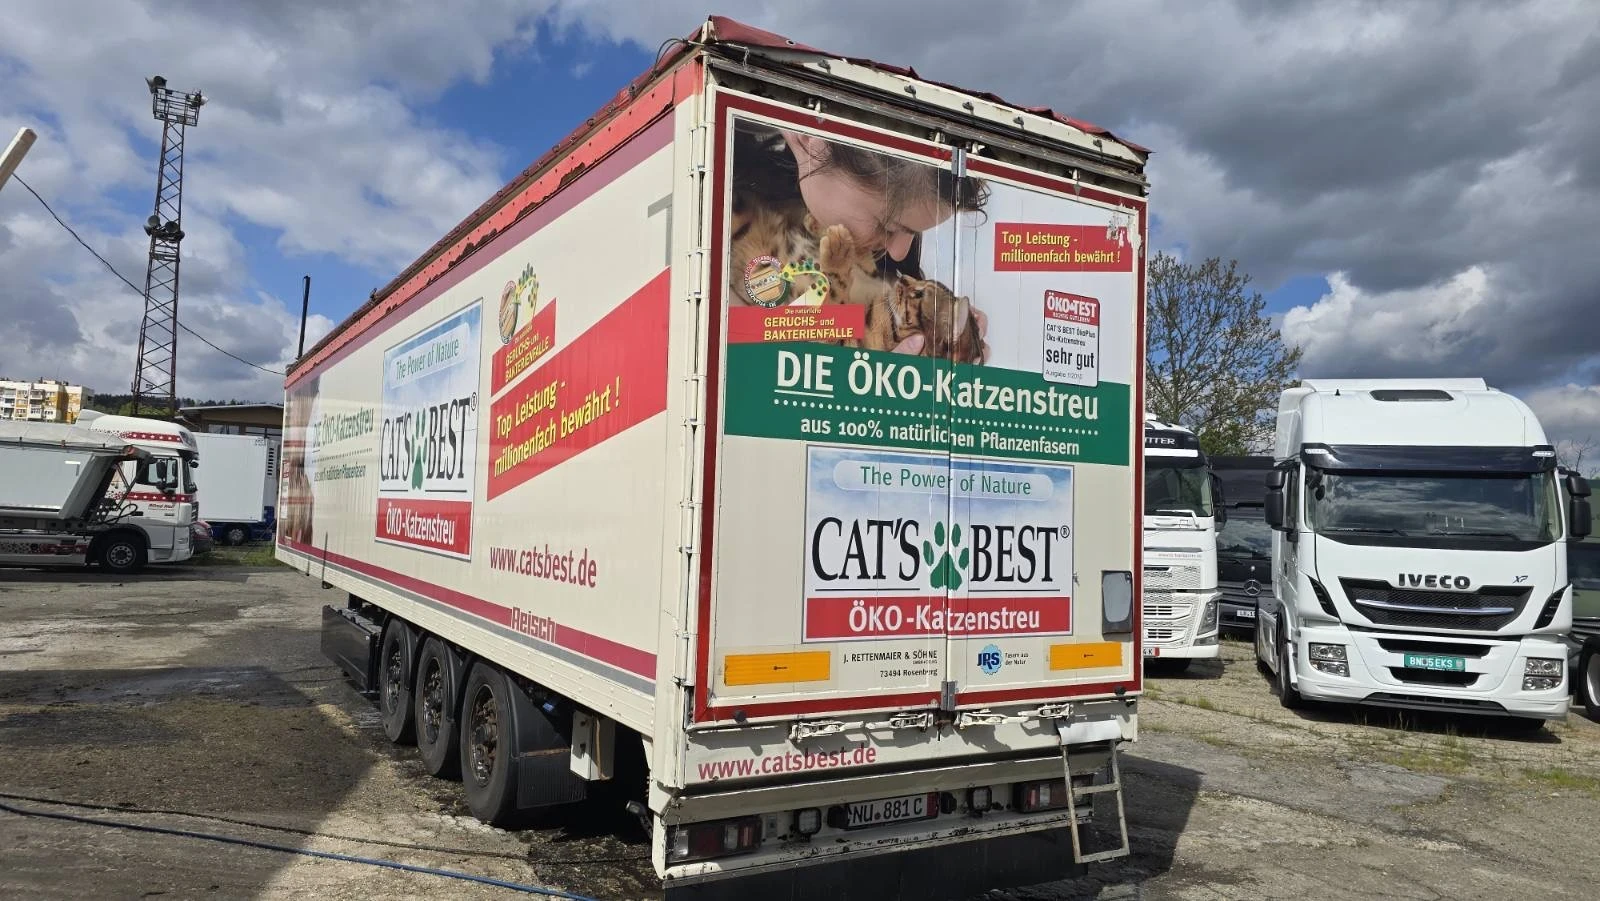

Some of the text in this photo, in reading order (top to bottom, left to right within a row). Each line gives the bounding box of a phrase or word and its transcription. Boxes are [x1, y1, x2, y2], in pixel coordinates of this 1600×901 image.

[1002, 231, 1022, 246] Top
[1026, 232, 1070, 248] Leistung
[1001, 249, 1070, 262] millionenfach
[1074, 250, 1114, 263] bewährt
[764, 316, 834, 328] GERUCHS- und
[764, 328, 854, 340] BAKTERIENFALLE
[1062, 326, 1075, 336] BEST
[396, 338, 459, 380] The Power of Nature
[1046, 347, 1094, 370] sehr gut
[777, 350, 1098, 420] DIE ÖKO-Katzenstreu
[496, 413, 512, 439] Top
[515, 380, 558, 428] Leistung
[494, 418, 556, 477] millionenfach
[560, 384, 612, 438] bewährt
[800, 418, 1080, 456] aus 100% natürlichen Pflanzenfasern
[380, 412, 412, 482] CAT'S
[860, 466, 1031, 496] The Power of Nature
[812, 516, 920, 581] CAT'S
[490, 543, 598, 588] www.catsbest.de
[1398, 573, 1471, 590] IVECO
[844, 654, 848, 663] J.
[852, 652, 902, 662] RETTENMAIER
[913, 649, 938, 660] SÖHNE
[977, 652, 1000, 670] JRS
[698, 743, 877, 780] www.catsbest.de
[853, 804, 874, 824] NU
